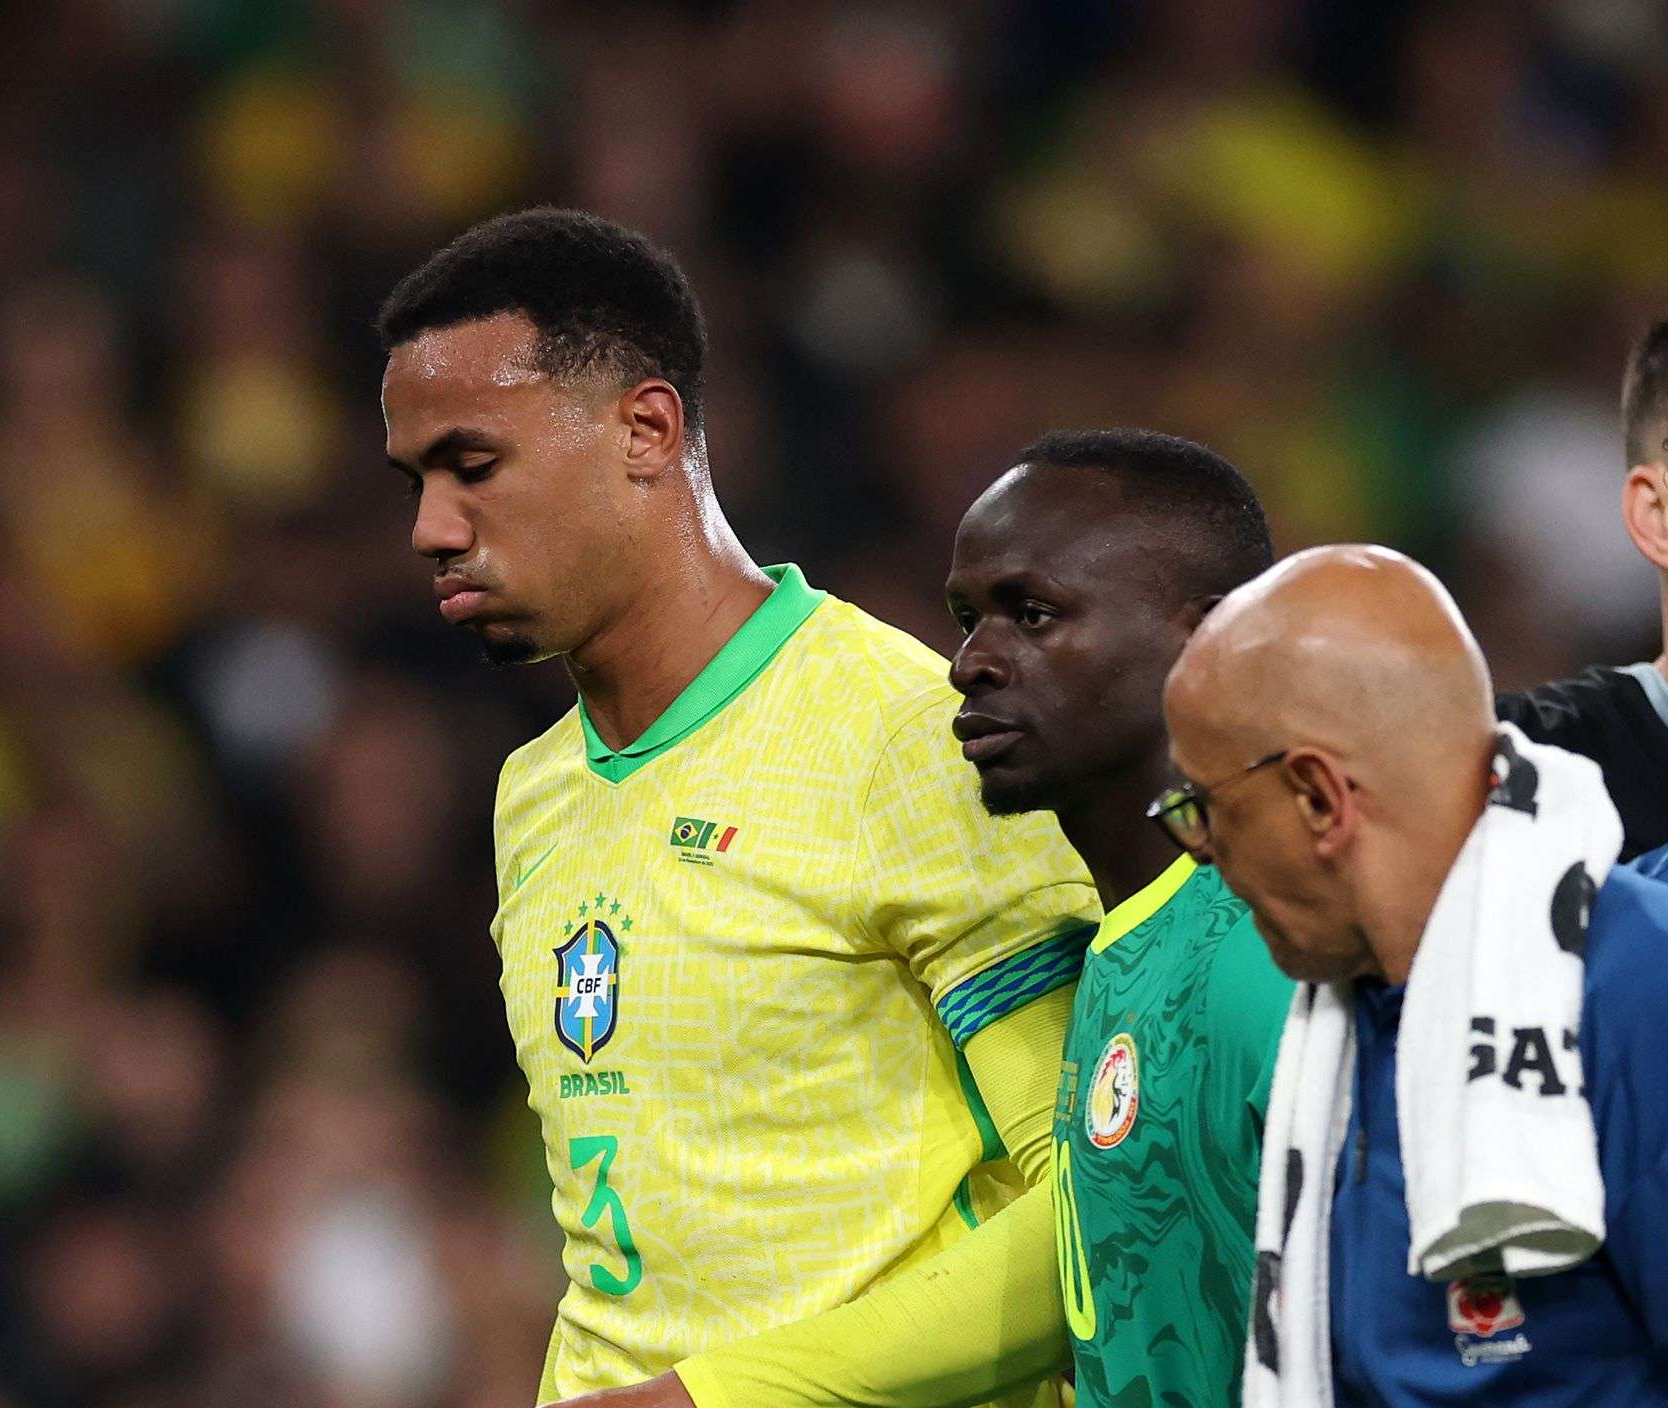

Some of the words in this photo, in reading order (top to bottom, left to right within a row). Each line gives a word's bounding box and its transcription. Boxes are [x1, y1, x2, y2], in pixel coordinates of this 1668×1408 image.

[577, 977, 602, 994] CBF
[559, 1071, 630, 1099] BRASIL
[568, 1135, 642, 1298] 3
